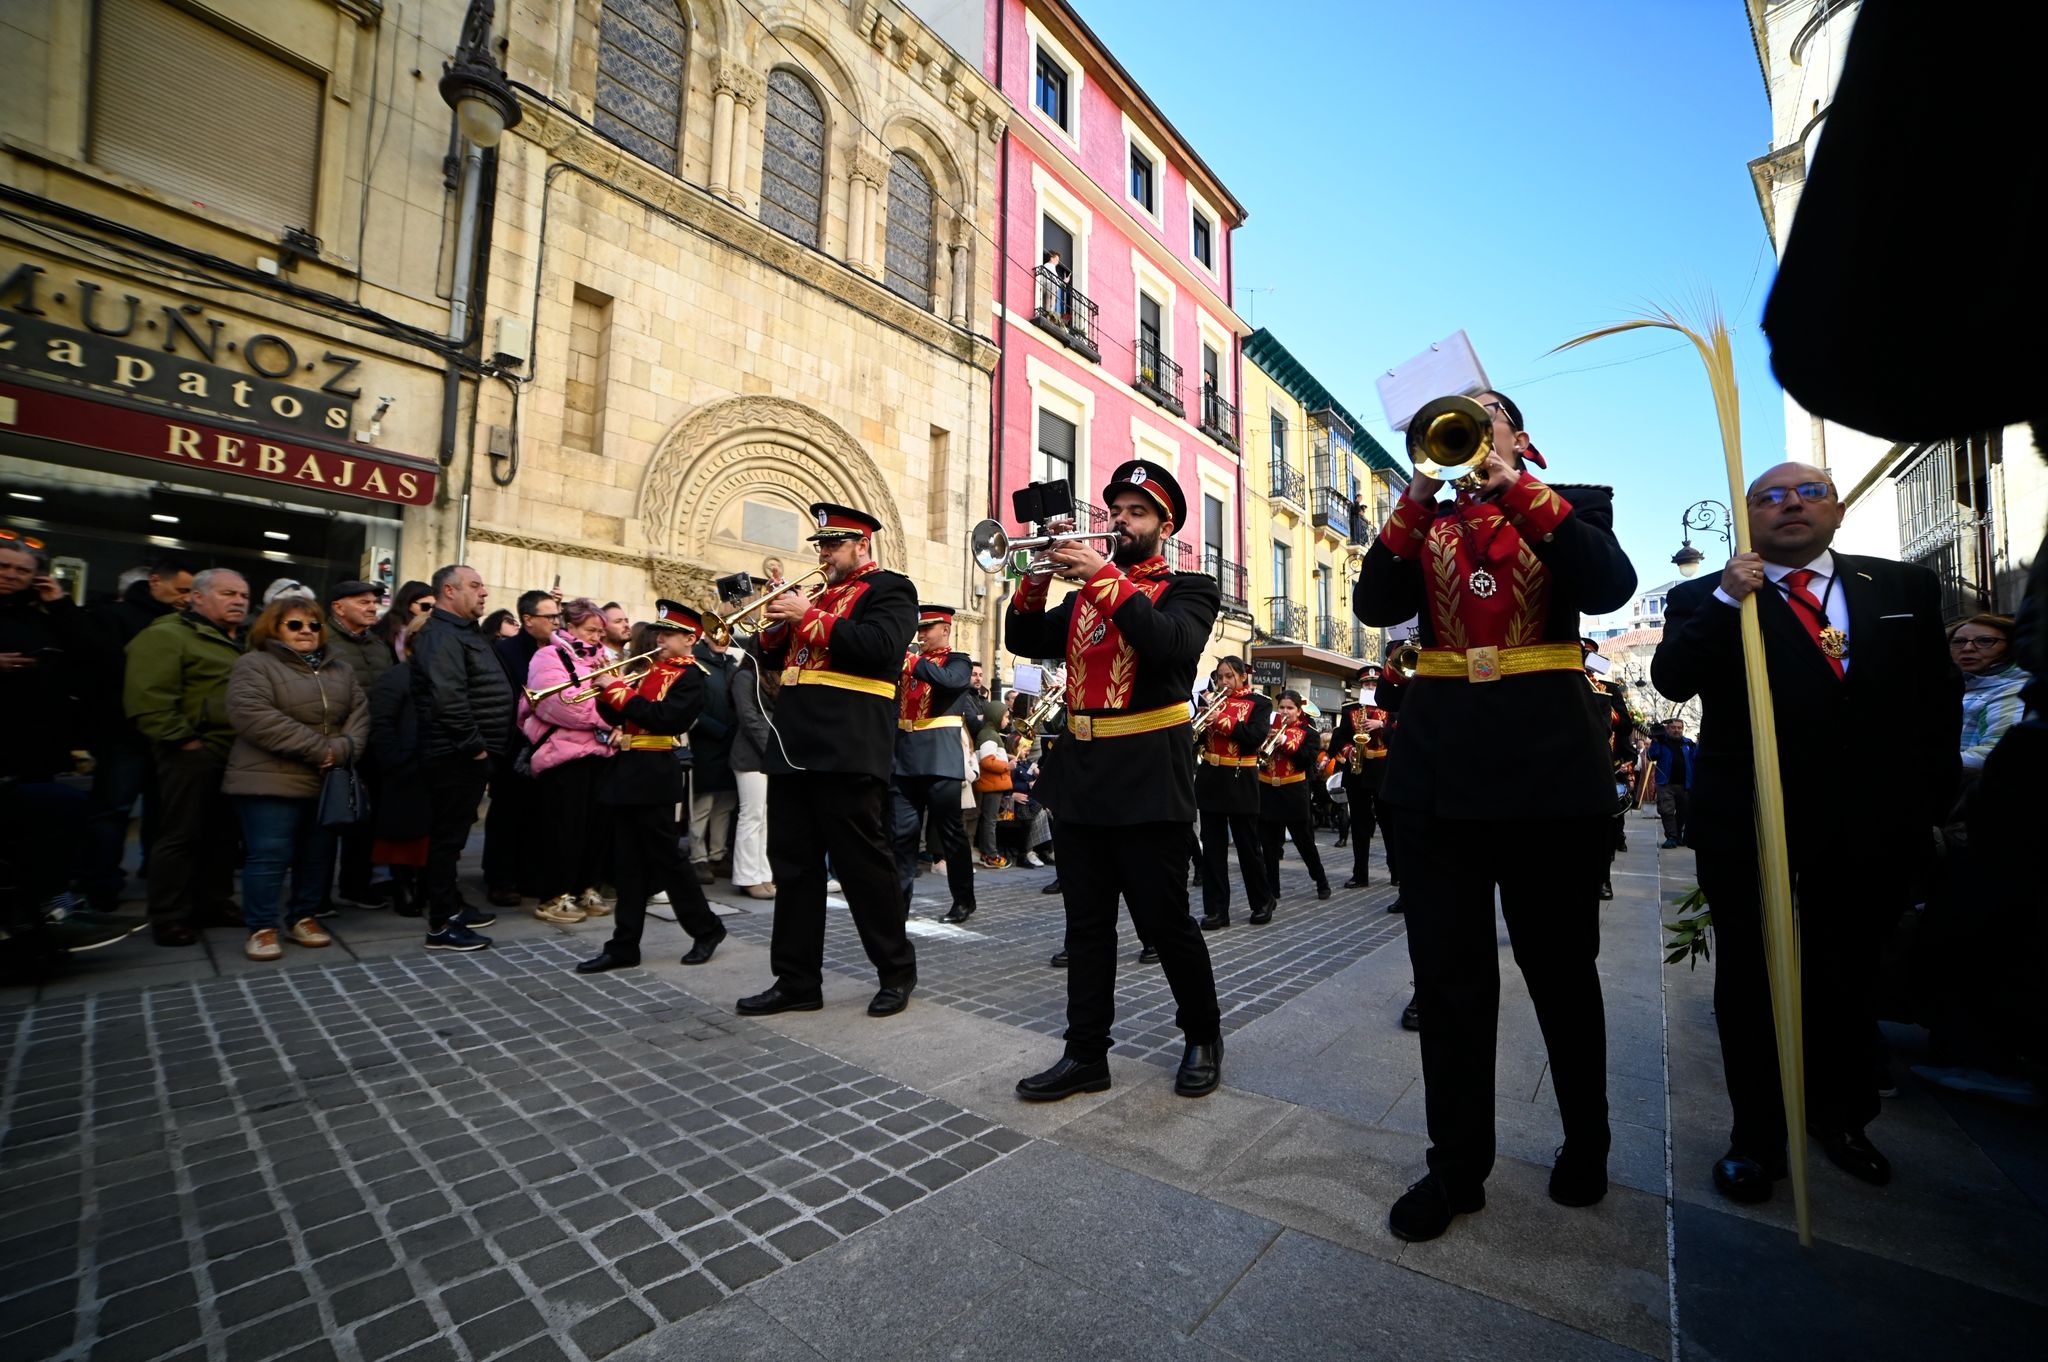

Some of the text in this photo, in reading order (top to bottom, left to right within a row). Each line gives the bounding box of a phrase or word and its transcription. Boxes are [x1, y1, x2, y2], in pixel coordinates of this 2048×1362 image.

[165, 424, 419, 499] REBAJAS
[1255, 661, 1281, 669] CENTRO
[1253, 675, 1282, 684] MASAJES
